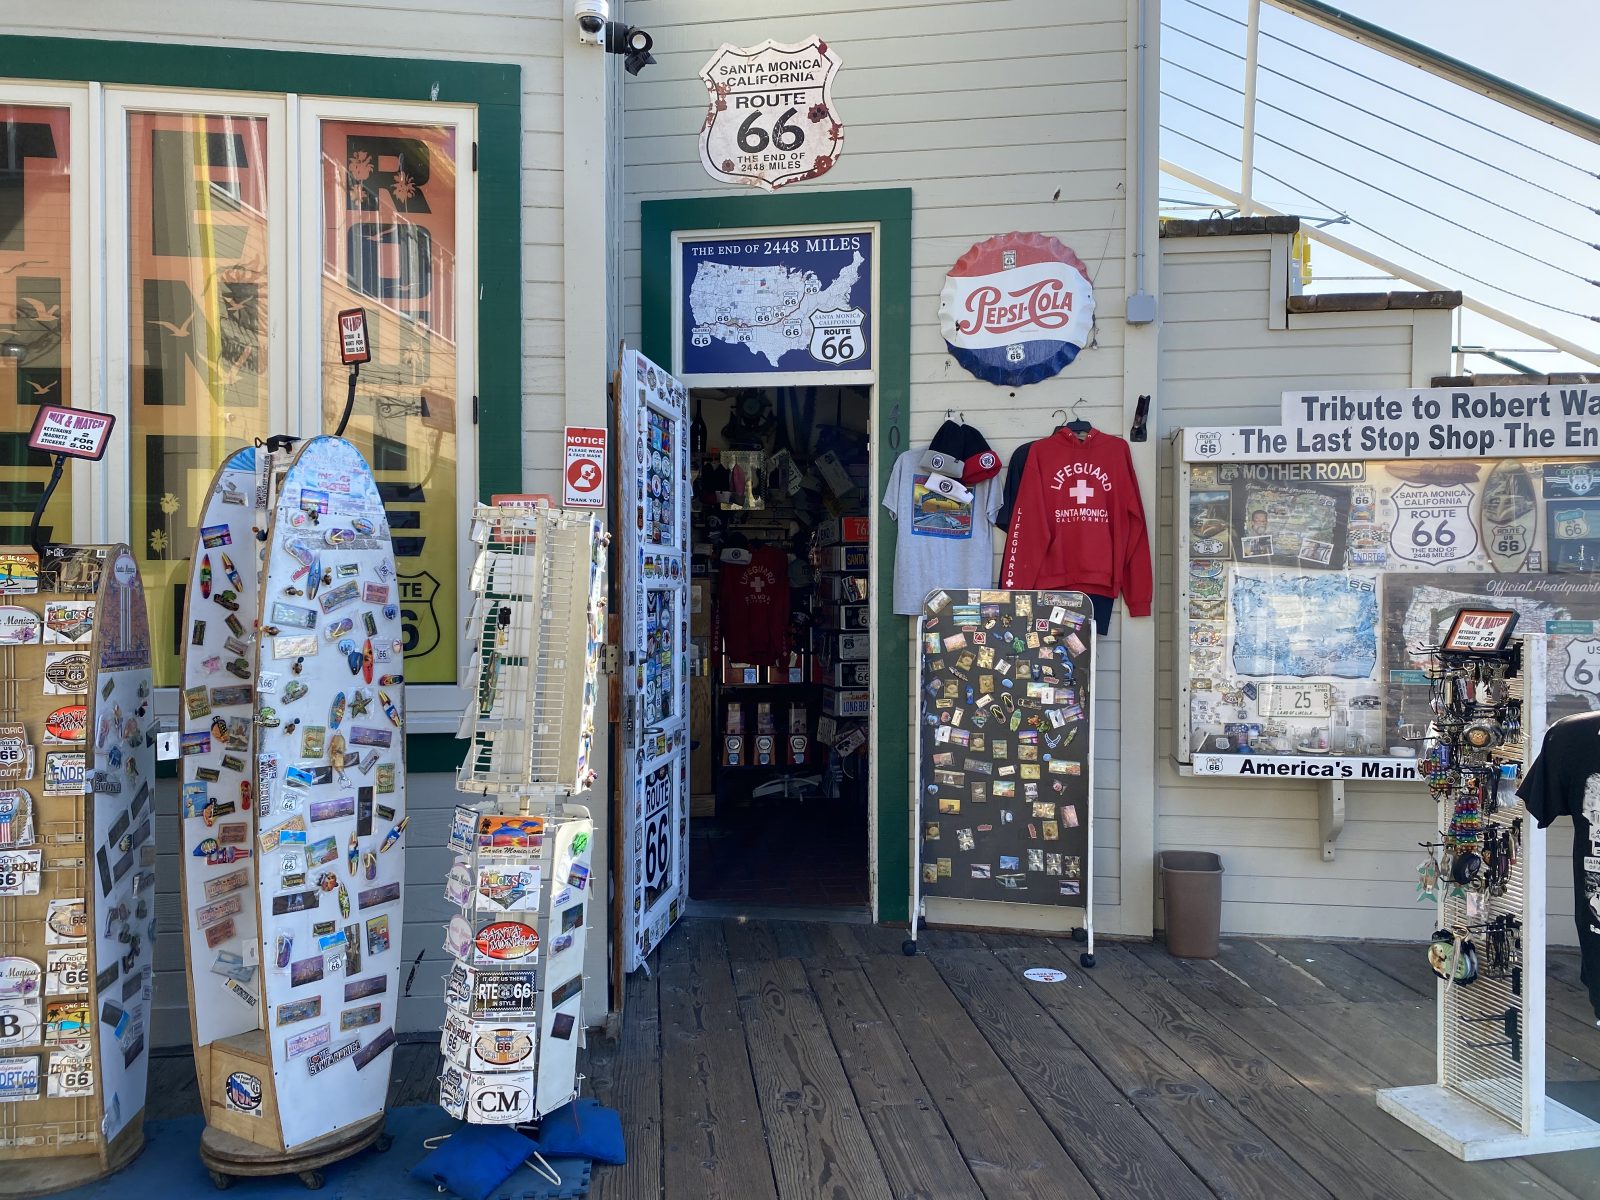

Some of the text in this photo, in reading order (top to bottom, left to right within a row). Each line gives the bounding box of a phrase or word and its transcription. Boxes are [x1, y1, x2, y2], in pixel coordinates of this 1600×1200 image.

[720, 59, 821, 76] SANTA MONICA
[727, 72, 815, 87] CALIFORNIA
[735, 91, 806, 109] ROUTE
[737, 107, 805, 153] 66
[737, 152, 805, 164] THE END OF
[741, 160, 801, 172] 2448 MILES
[692, 236, 861, 256] THE END OF 2448 MILES
[785, 327, 799, 335] 66
[823, 328, 851, 336] ROUTE
[694, 336, 709, 344] 66
[821, 336, 854, 361] 66
[1010, 352, 1021, 360] 66
[1301, 395, 1402, 421] Tribute
[1412, 394, 1441, 419] to
[1452, 391, 1551, 419] Robert
[48, 412, 105, 430] MIX & MATCH
[43, 426, 72, 434] KEYCHAINS
[73, 437, 94, 445] FOR
[567, 436, 605, 445] NOTICE
[1239, 429, 1287, 454] The
[1296, 427, 1351, 453] Last
[1360, 425, 1420, 456] Stop
[1429, 424, 1495, 455] Shop
[1504, 422, 1555, 448] The
[70, 442, 93, 451] 5.00
[1200, 444, 1217, 453] 66
[1051, 462, 1112, 492] LIFEGUARD
[1242, 462, 1364, 480] MOTHER ROAD
[1355, 496, 1368, 505] 66
[1400, 490, 1466, 499] SANTA MONICA
[1404, 498, 1462, 506] CALIFORNIA
[1055, 508, 1108, 518] SANTA MONICA
[1411, 509, 1456, 519] ROUTE
[1412, 519, 1456, 547] 66
[1565, 523, 1582, 537] 66
[1008, 508, 1022, 578] LIFEGUARD
[1498, 540, 1519, 552] 66
[847, 554, 865, 566] SANTA
[1486, 579, 1532, 597] Official
[4, 615, 36, 625] Monica
[49, 610, 86, 621] KICKS
[1464, 616, 1477, 627] MIX
[1482, 617, 1507, 629] MATCH
[71, 673, 82, 681] 66
[1295, 691, 1311, 709] 25
[843, 701, 858, 712] LONG
[0, 751, 18, 760] 66
[1240, 759, 1415, 778] America's Main
[646, 779, 669, 812] ROUTE
[284, 800, 294, 809] 66
[503, 846, 528, 854] Monica
[646, 813, 668, 884] 66
[12, 861, 38, 872] RIDE
[284, 861, 293, 870] 66
[482, 873, 520, 887] KICKS
[72, 915, 87, 924] 66
[480, 925, 521, 941] SANTA
[490, 934, 537, 950] MONICA
[50, 962, 78, 972] LET'S
[331, 960, 341, 970] 66
[6, 966, 37, 977] Monica
[65, 970, 88, 983] 66
[479, 983, 531, 999] RTE 66
[60, 1002, 78, 1011] LONG
[497, 1042, 511, 1051] 66
[51, 1063, 77, 1074] LET'S
[66, 1072, 88, 1087] 66
[478, 1090, 522, 1112] CM
